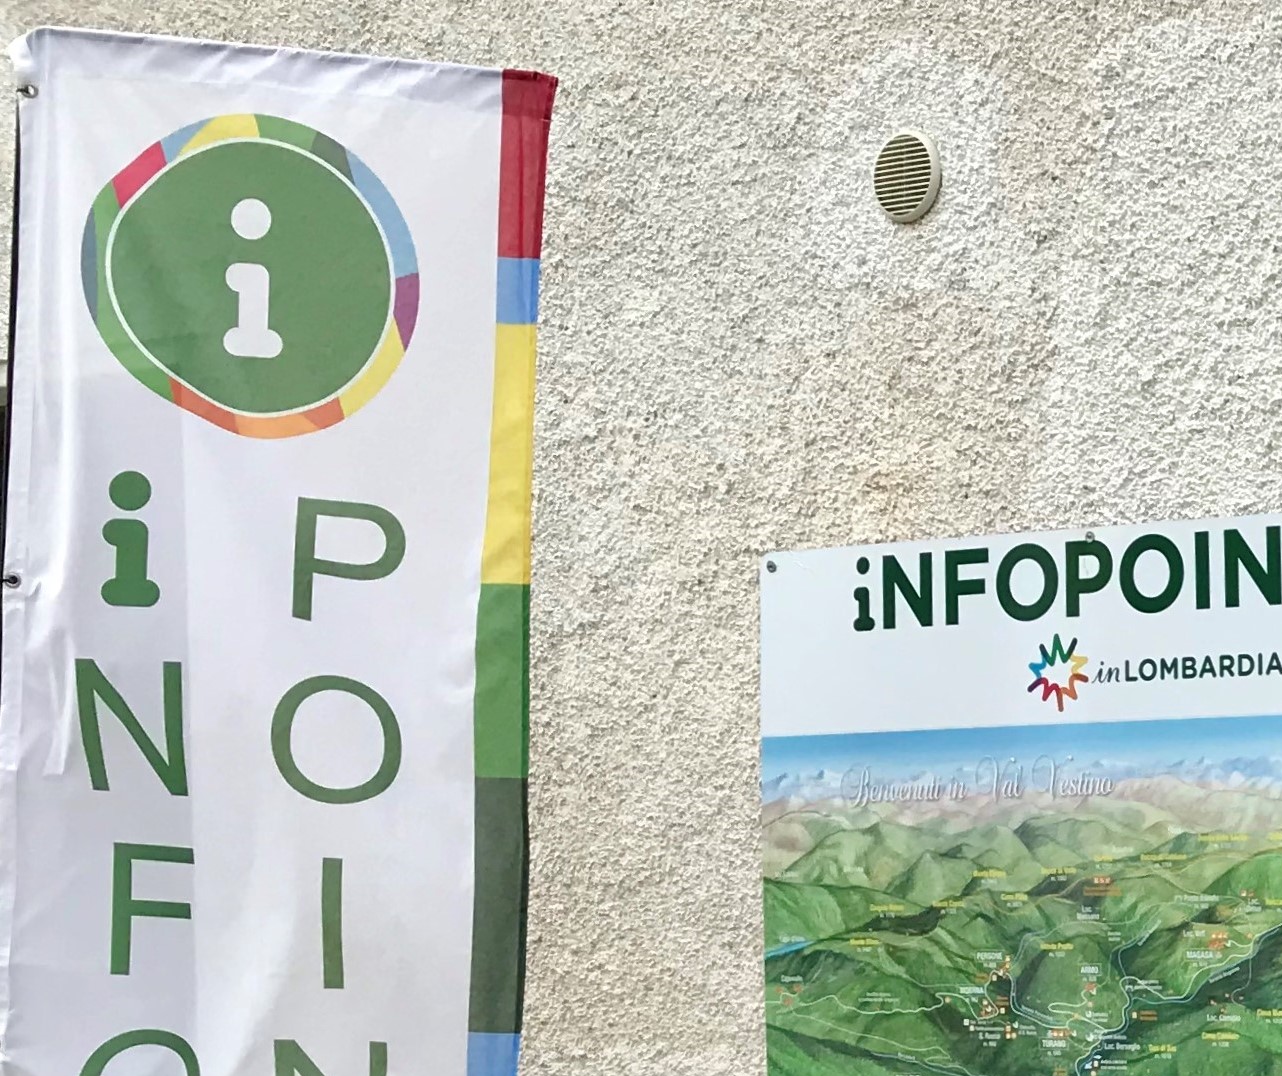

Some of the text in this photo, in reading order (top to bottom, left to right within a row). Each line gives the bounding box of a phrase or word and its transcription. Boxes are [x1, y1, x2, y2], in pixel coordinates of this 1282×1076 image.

[841, 755, 1114, 808] Benvenuti in Val Vestino
